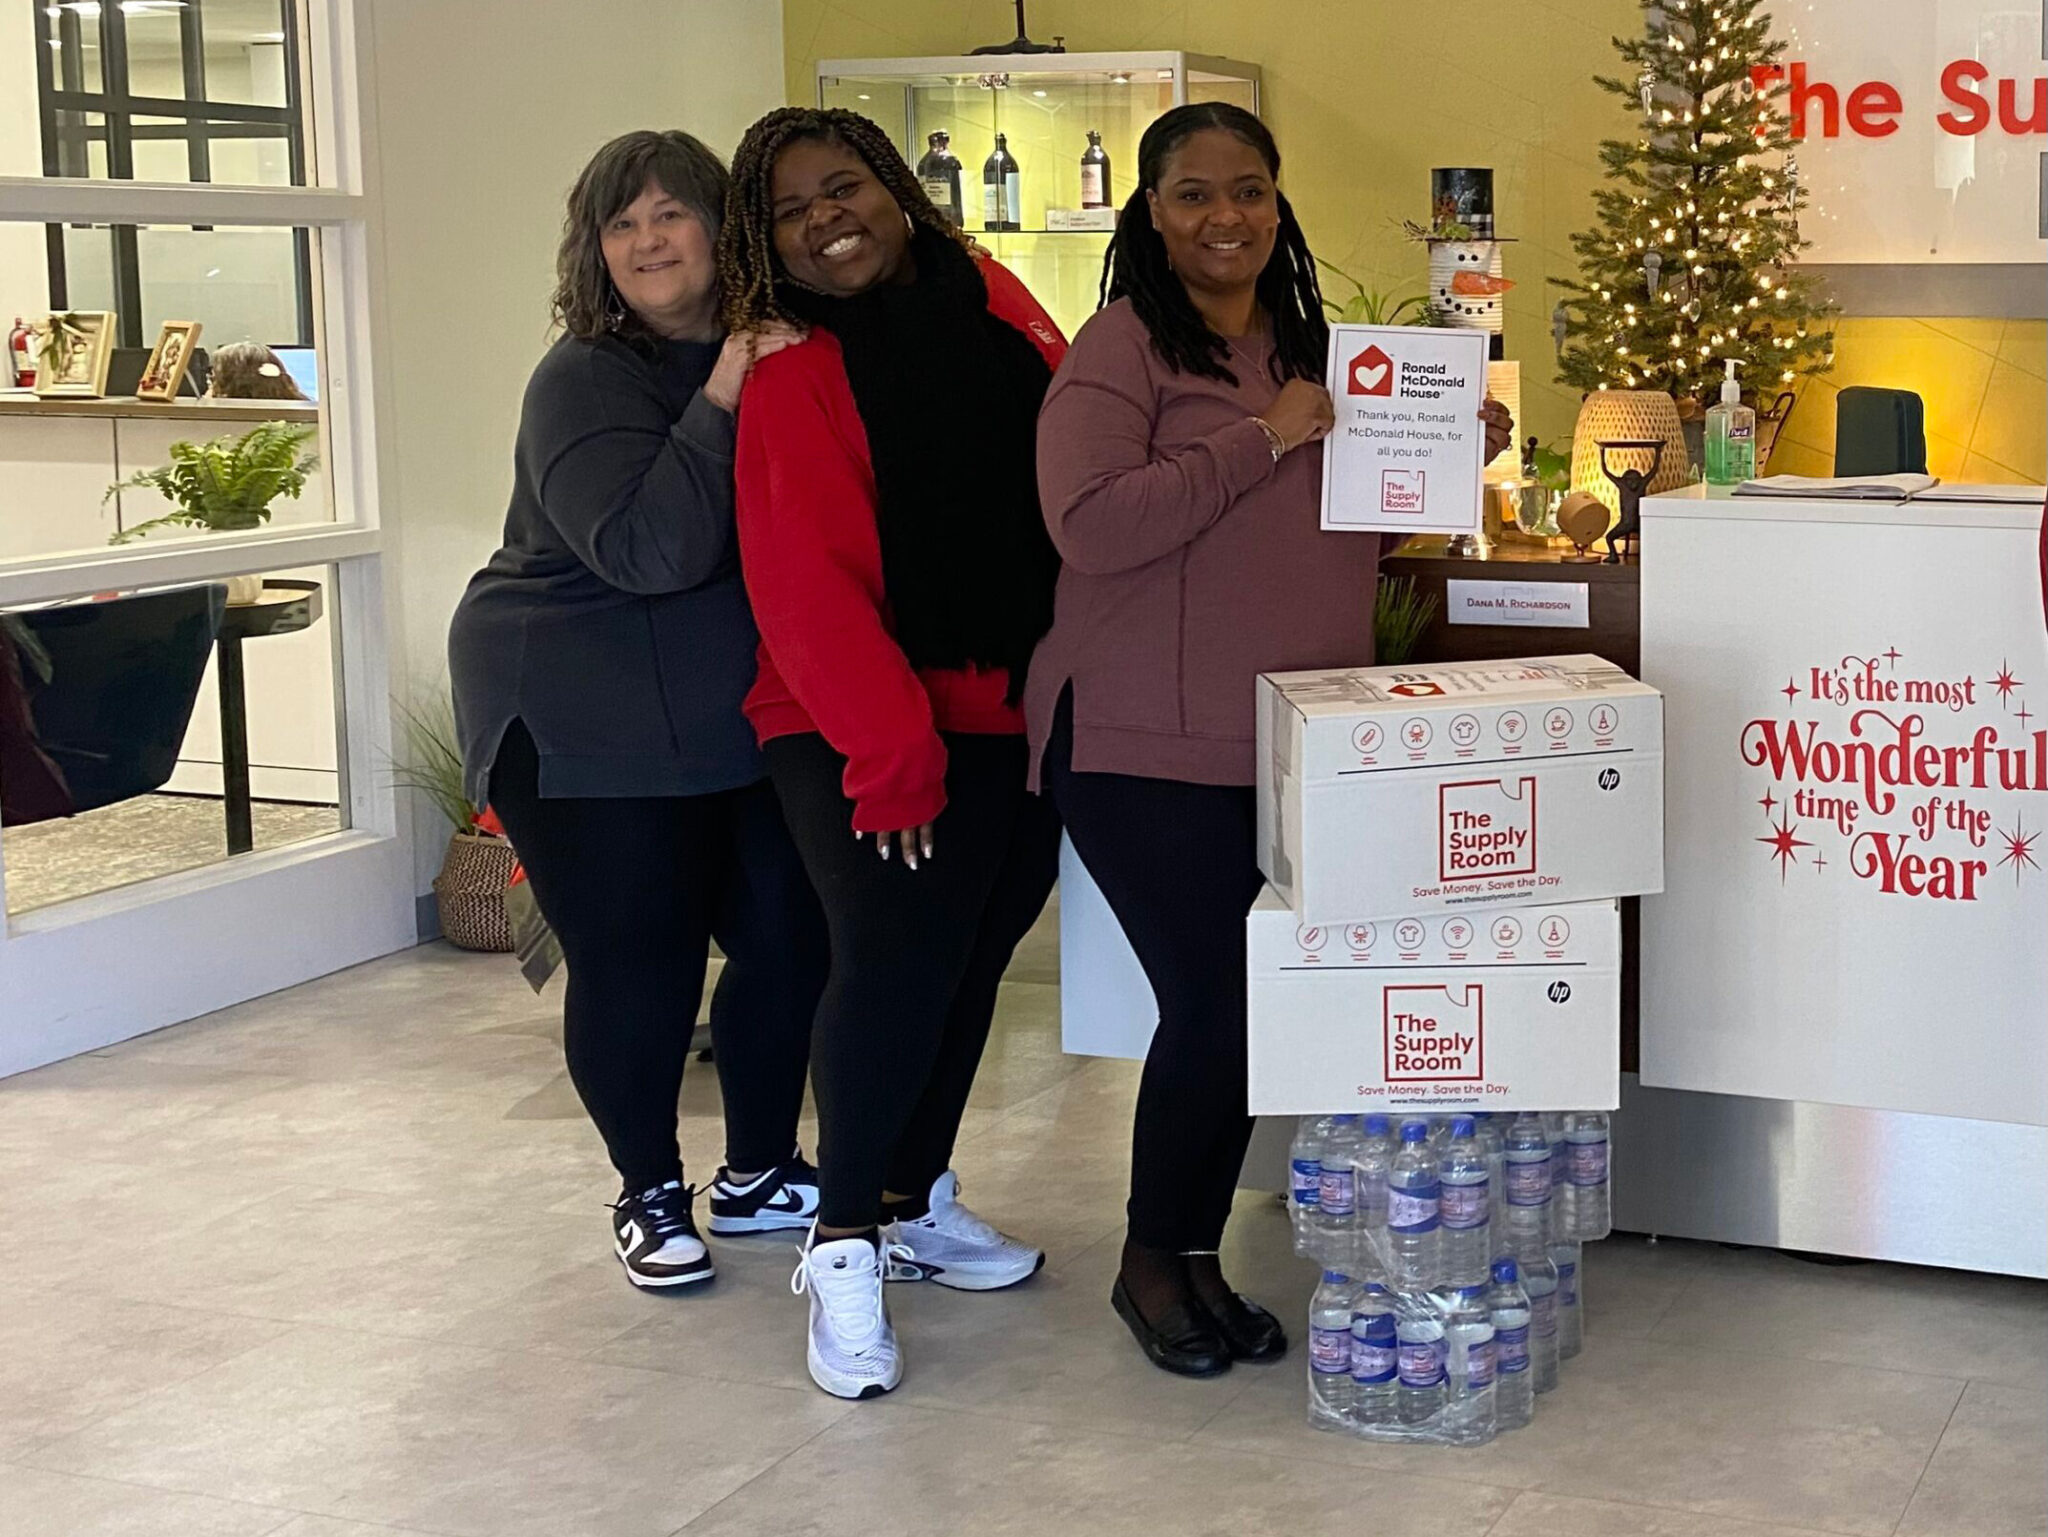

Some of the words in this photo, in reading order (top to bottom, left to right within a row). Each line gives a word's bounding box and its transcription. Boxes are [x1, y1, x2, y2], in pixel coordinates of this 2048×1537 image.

[1936, 59, 2048, 137] Su
[1402, 362, 1446, 375] Ronald
[1401, 374, 1465, 388] McDonald
[1400, 386, 1441, 399] House
[1356, 409, 1389, 421] Thank
[1392, 413, 1415, 427] you,
[1417, 411, 1456, 424] Ronald
[1348, 427, 1404, 439] McDonald
[1406, 429, 1445, 442] House,
[1447, 431, 1463, 441] for
[1377, 446, 1391, 457] all
[1392, 449, 1412, 460] you
[1414, 448, 1432, 458] do!
[1385, 490, 1420, 501] Supply
[1386, 482, 1405, 491] The
[1385, 499, 1415, 509] Room
[1495, 598, 1508, 609] M.
[1810, 667, 1849, 706] It's
[1842, 656, 1899, 702] the
[1904, 675, 1976, 712] most
[1740, 709, 2048, 815] Wonderful
[1598, 767, 1620, 791] hp
[1449, 810, 1492, 830] The
[1794, 788, 1860, 836] time
[1912, 796, 1942, 841] of
[1944, 799, 1991, 847] the
[1449, 826, 1528, 851] Supply
[1450, 850, 1516, 870] Room
[1850, 831, 1987, 901] Year
[1412, 887, 1440, 898] Save
[1443, 883, 1484, 896] Money.
[1487, 880, 1515, 891] Save
[1517, 878, 1536, 888] the
[1538, 875, 1563, 887] Day.
[1445, 891, 1533, 905] www.thesupplyroom.com
[1547, 980, 1571, 1004] hp
[1393, 1014, 1437, 1033] The
[1394, 1032, 1475, 1055] Supply
[1395, 1053, 1462, 1071] Room
[1357, 1085, 1385, 1095] Save
[1388, 1085, 1430, 1097] Money.
[1433, 1085, 1461, 1095] Save
[1464, 1084, 1483, 1094] the
[1486, 1084, 1511, 1096] Day.
[1390, 1097, 1479, 1106] www.thesupplyroom.com
